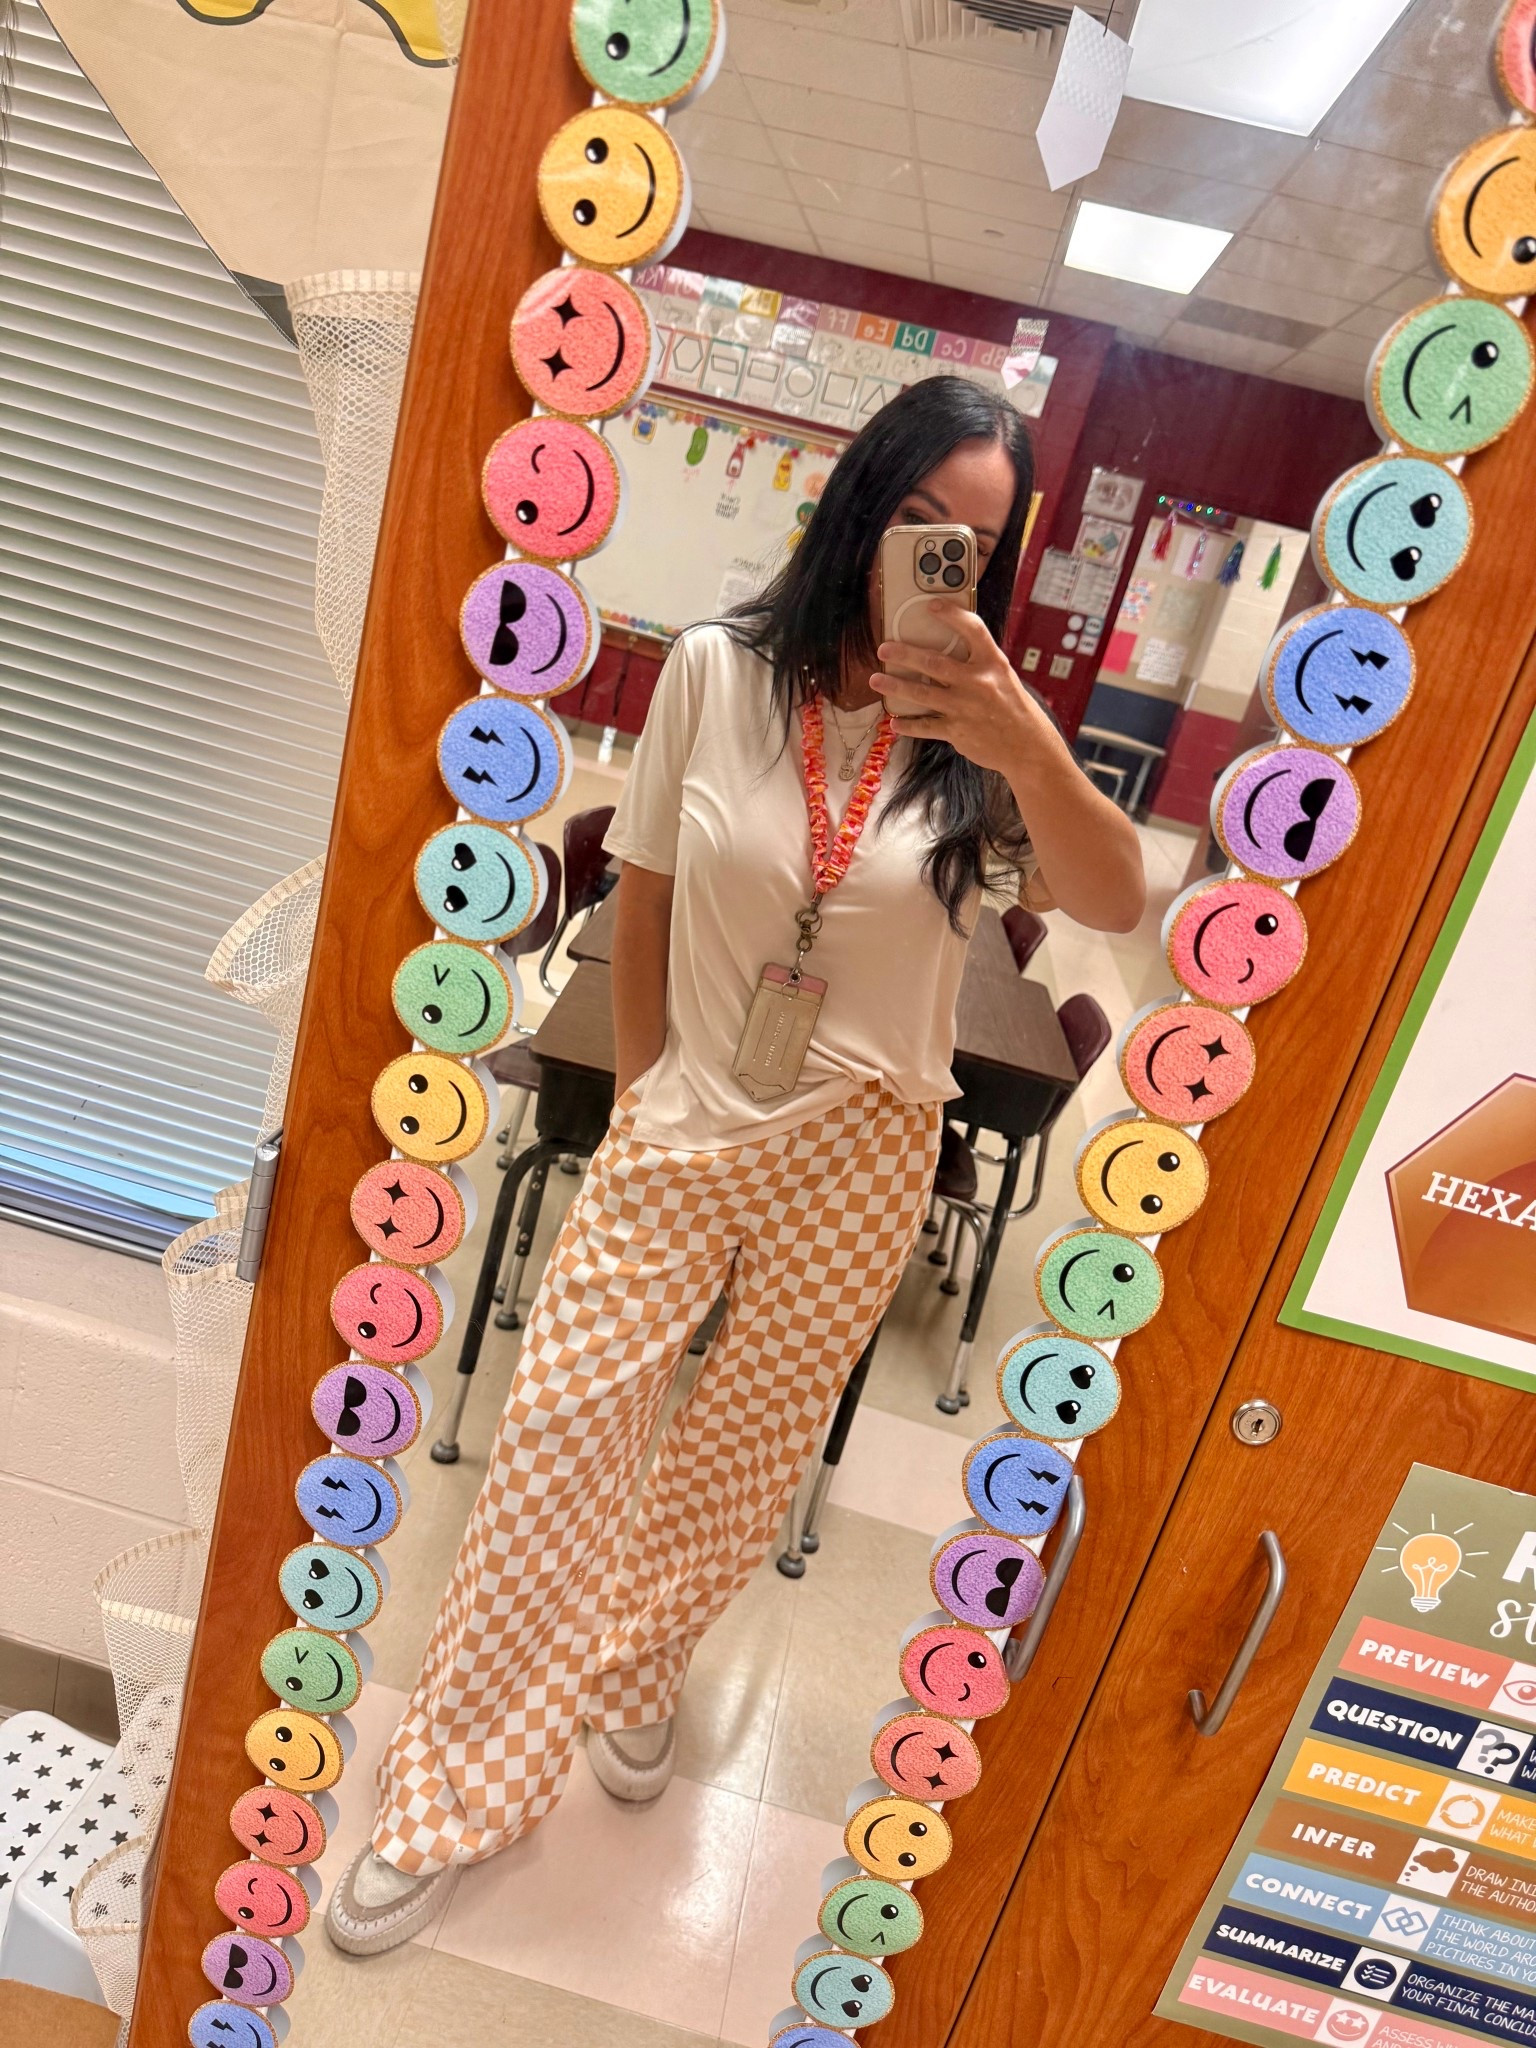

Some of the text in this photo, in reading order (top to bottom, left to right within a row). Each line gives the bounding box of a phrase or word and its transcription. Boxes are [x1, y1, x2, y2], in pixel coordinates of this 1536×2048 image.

[1358, 1638, 1490, 1689] PREVIEW
[1326, 1699, 1463, 1750] QUESTION
[1307, 1762, 1422, 1806] PREDICT
[1291, 1823, 1376, 1859] INFER
[1489, 1824, 1531, 1845] WHAT
[1465, 1865, 1508, 1887] DRAW
[1246, 1873, 1373, 1920] CONNECT
[1460, 1880, 1536, 1913] THE AUTHO
[1216, 1924, 1346, 1972] SUMMARIZE
[1435, 1928, 1462, 1945] THE
[1463, 1937, 1509, 1957] WORLD
[1442, 1914, 1536, 1950] THINK ABOUT
[1425, 1942, 1496, 1970] PICTURES
[1496, 1961, 1520, 1977] IN
[1188, 1974, 1320, 2024] EVALUATE
[1401, 1986, 1435, 2006] YOUR
[1435, 1996, 1480, 2020] FINAL
[1407, 1973, 1482, 2004] ORGANIZE
[1485, 1996, 1512, 2013] THE
[1378, 2025, 1434, 2048] ASSESS
